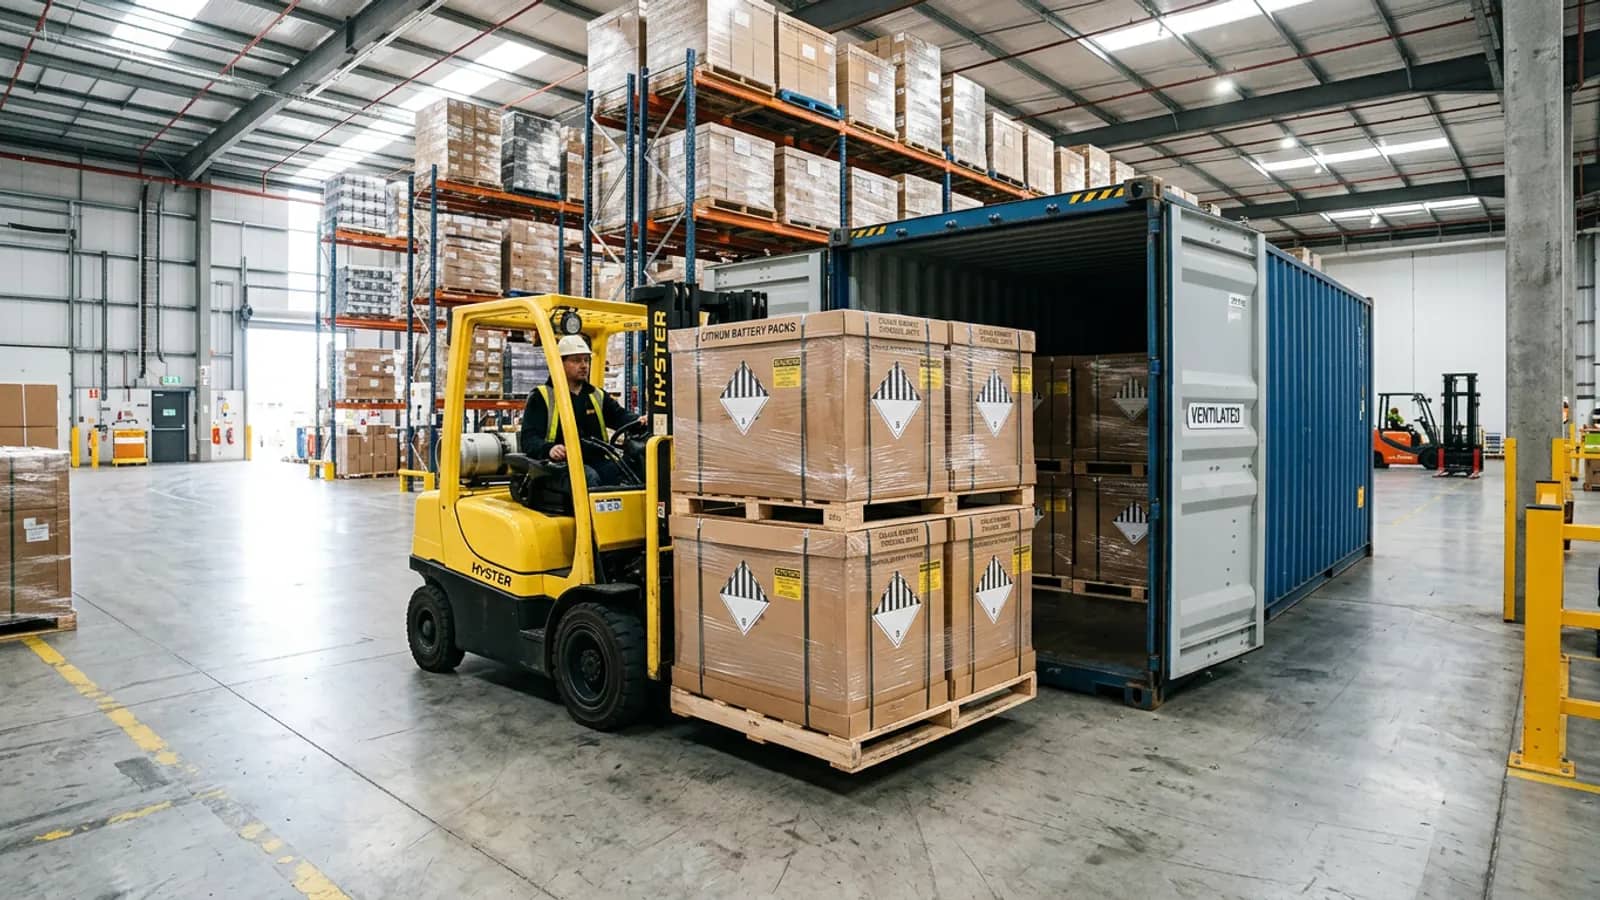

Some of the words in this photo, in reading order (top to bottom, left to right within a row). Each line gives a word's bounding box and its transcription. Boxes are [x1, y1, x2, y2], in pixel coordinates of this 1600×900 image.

[731, 325, 767, 339] BATTERY
[654, 310, 667, 408] HYSTER
[471, 561, 512, 588] HYSTER
